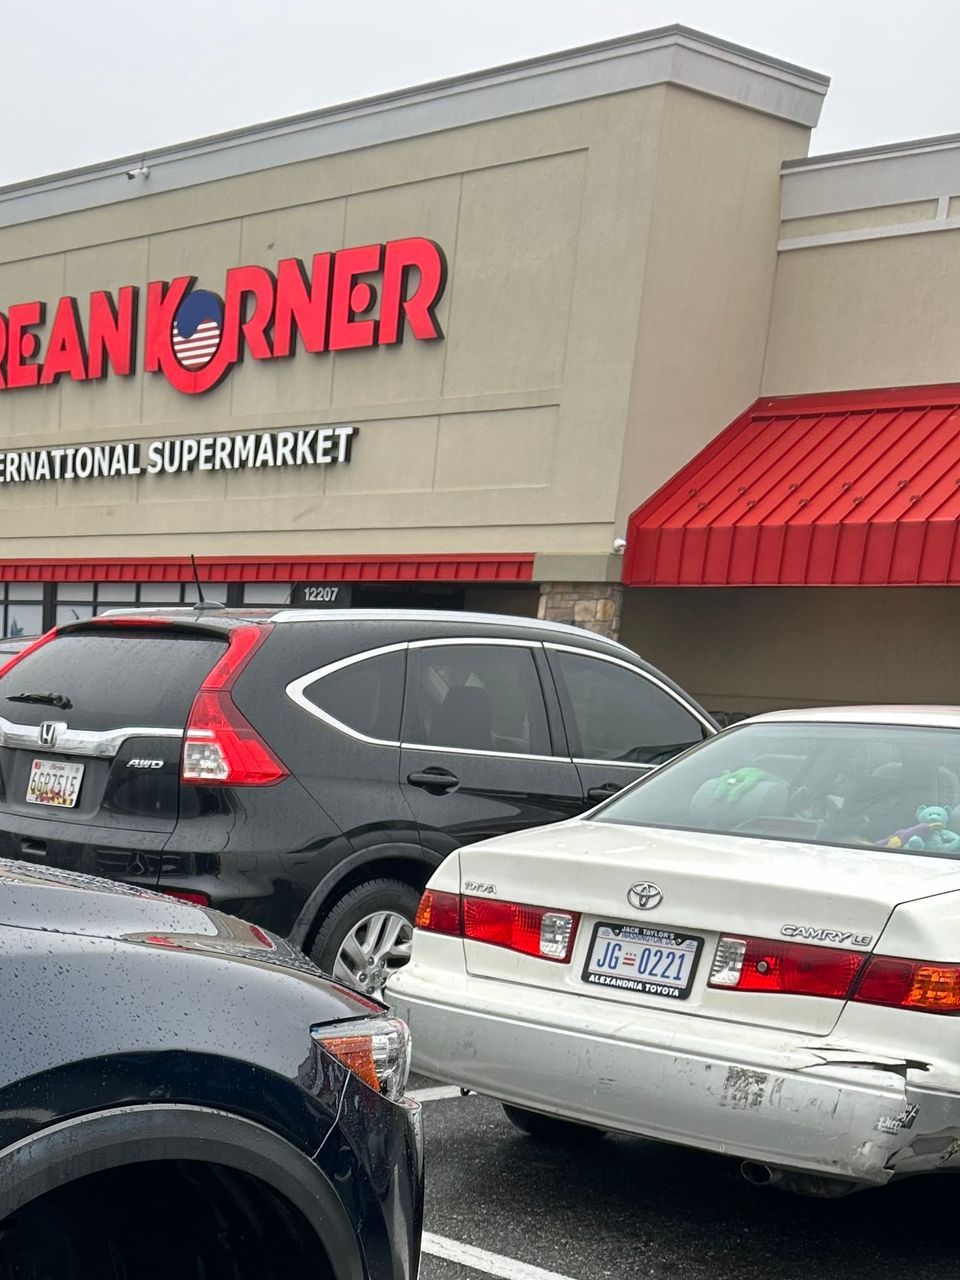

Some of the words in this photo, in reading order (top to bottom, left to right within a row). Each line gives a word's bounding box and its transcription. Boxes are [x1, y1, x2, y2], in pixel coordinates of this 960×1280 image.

[143, 236, 446, 394] KORNER
[146, 426, 356, 475] SUPERMARKET
[303, 587, 339, 602] 12207
[126, 759, 164, 769] AWD
[464, 880, 498, 895] TOYOTA
[622, 926, 639, 934] JACK
[642, 929, 674, 939] TAYLOR'S
[780, 924, 853, 944] CAMRY
[853, 935, 871, 945] LE
[597, 942, 621, 969] JG
[638, 948, 685, 980] 0221
[589, 975, 642, 990] ALEXANDRIA
[645, 984, 679, 996] TOYOTA
